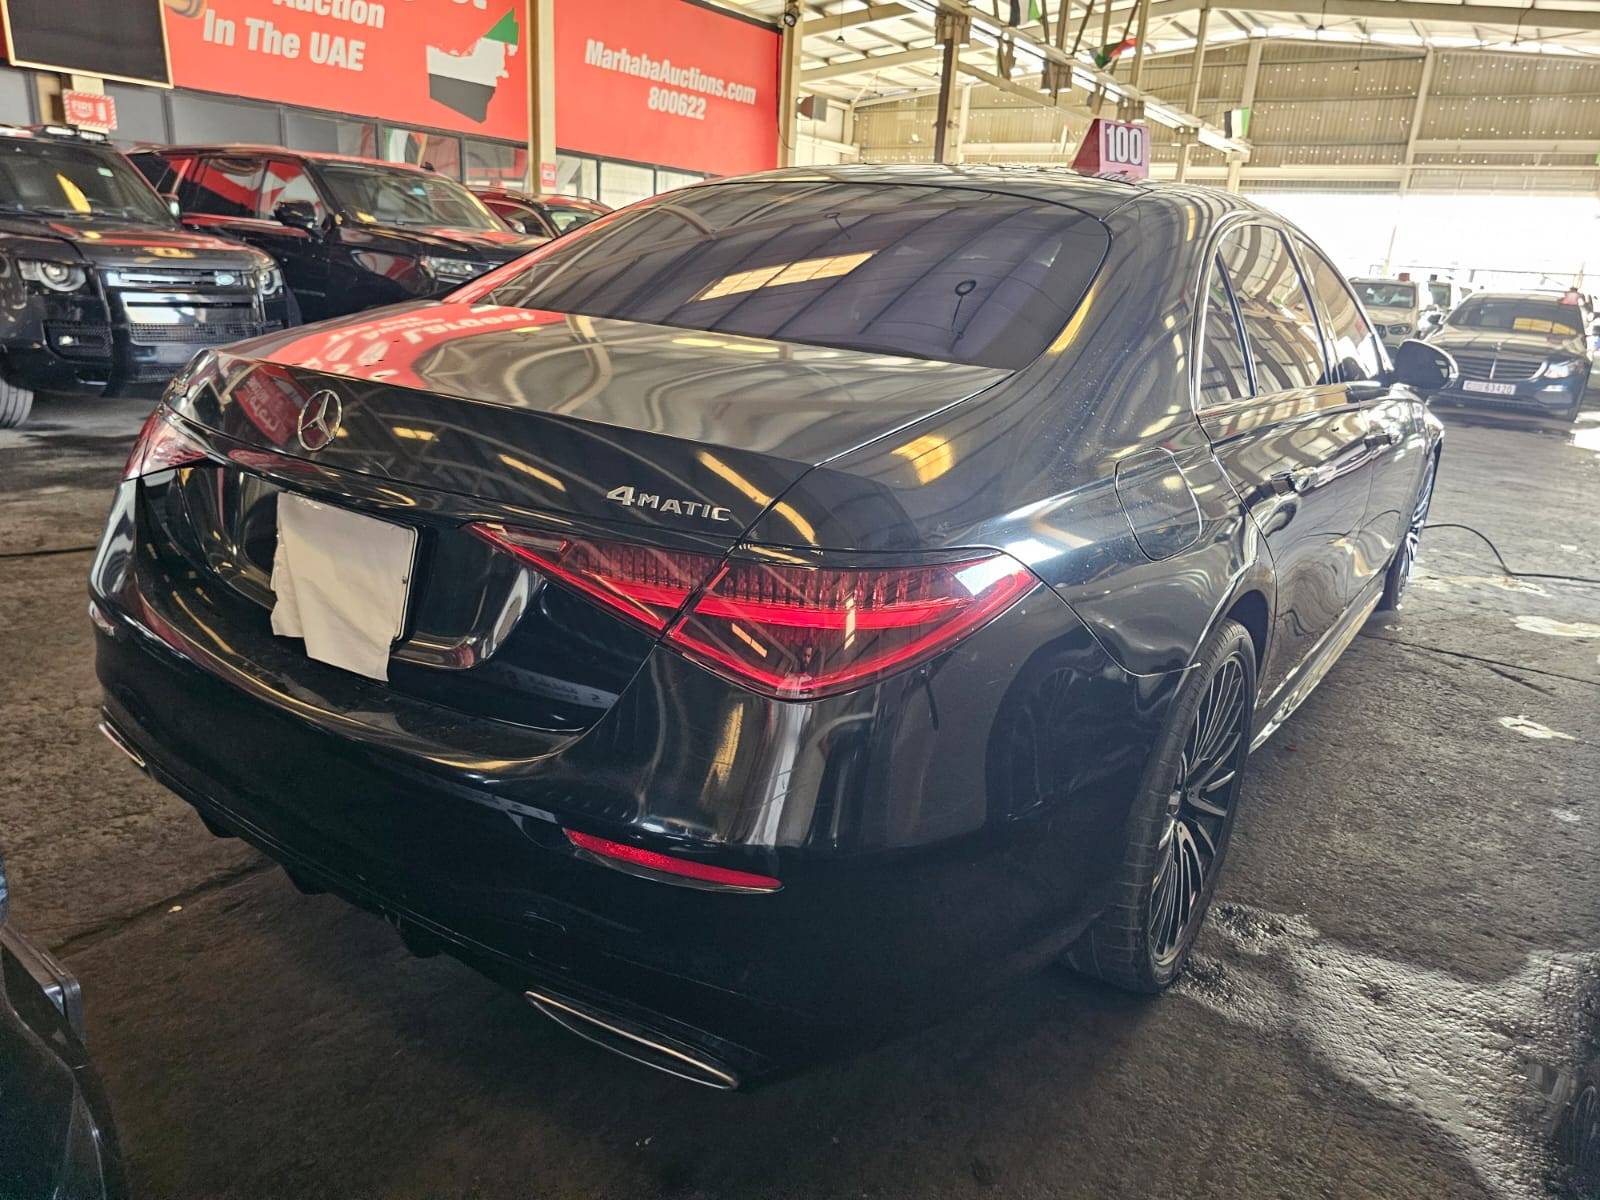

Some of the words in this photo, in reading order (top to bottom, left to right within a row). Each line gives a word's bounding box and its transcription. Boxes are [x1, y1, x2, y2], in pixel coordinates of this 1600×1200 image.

[272, 0, 385, 29] uction
[203, 9, 236, 46] In
[245, 17, 300, 58] The
[309, 32, 366, 71] UAE
[584, 38, 757, 105] MarhabaAuctions.com
[648, 86, 707, 120] 800622
[1106, 125, 1142, 165] 100
[606, 485, 731, 521] 4MATIC
